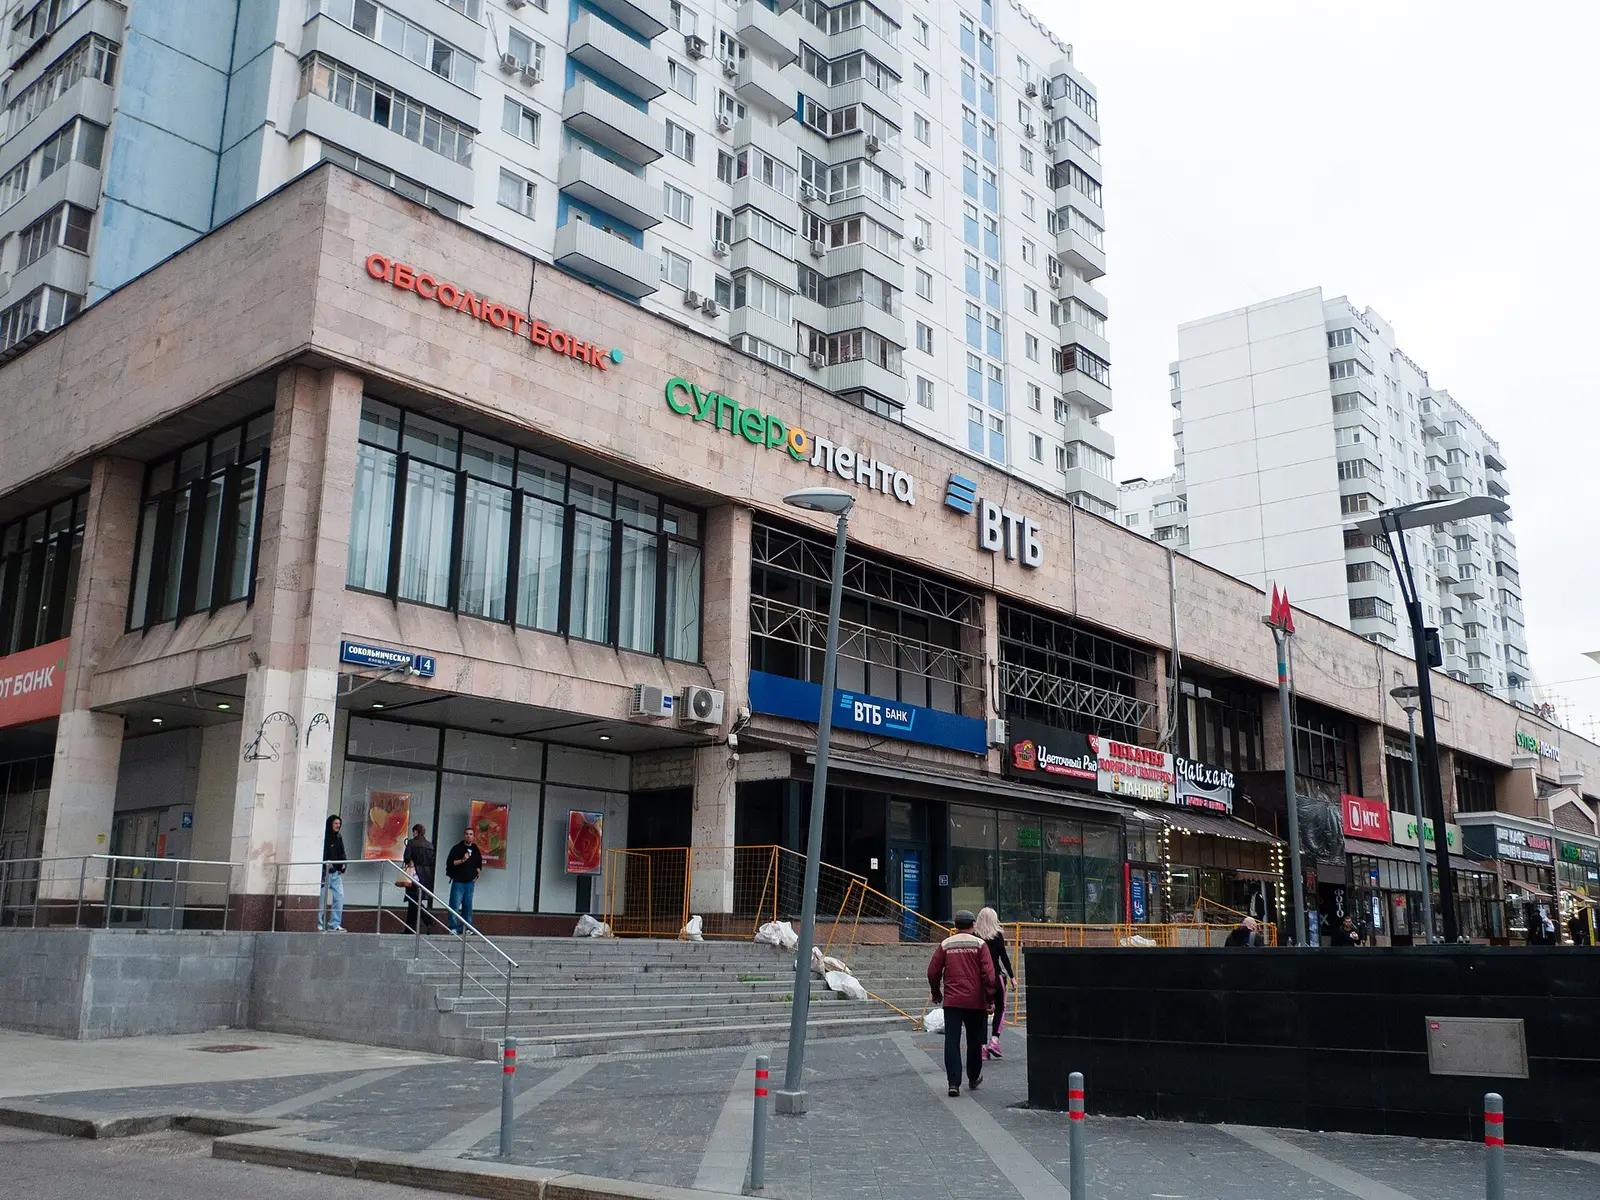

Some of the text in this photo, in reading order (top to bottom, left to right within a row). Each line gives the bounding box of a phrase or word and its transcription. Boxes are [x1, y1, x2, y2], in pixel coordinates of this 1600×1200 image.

[977, 498, 1044, 569] ВТБ
[348, 645, 411, 663] СОКОЛЬНИЧЕСКАЯ
[423, 659, 431, 671] 4
[854, 701, 908, 725] ВТБ БАНК
[1037, 745, 1082, 769] Цветочный
[1082, 754, 1097, 772] Ряд
[1176, 757, 1235, 789] Чайхана
[1121, 780, 1161, 800] ТАНДЫР
[1362, 810, 1380, 828] МТС
